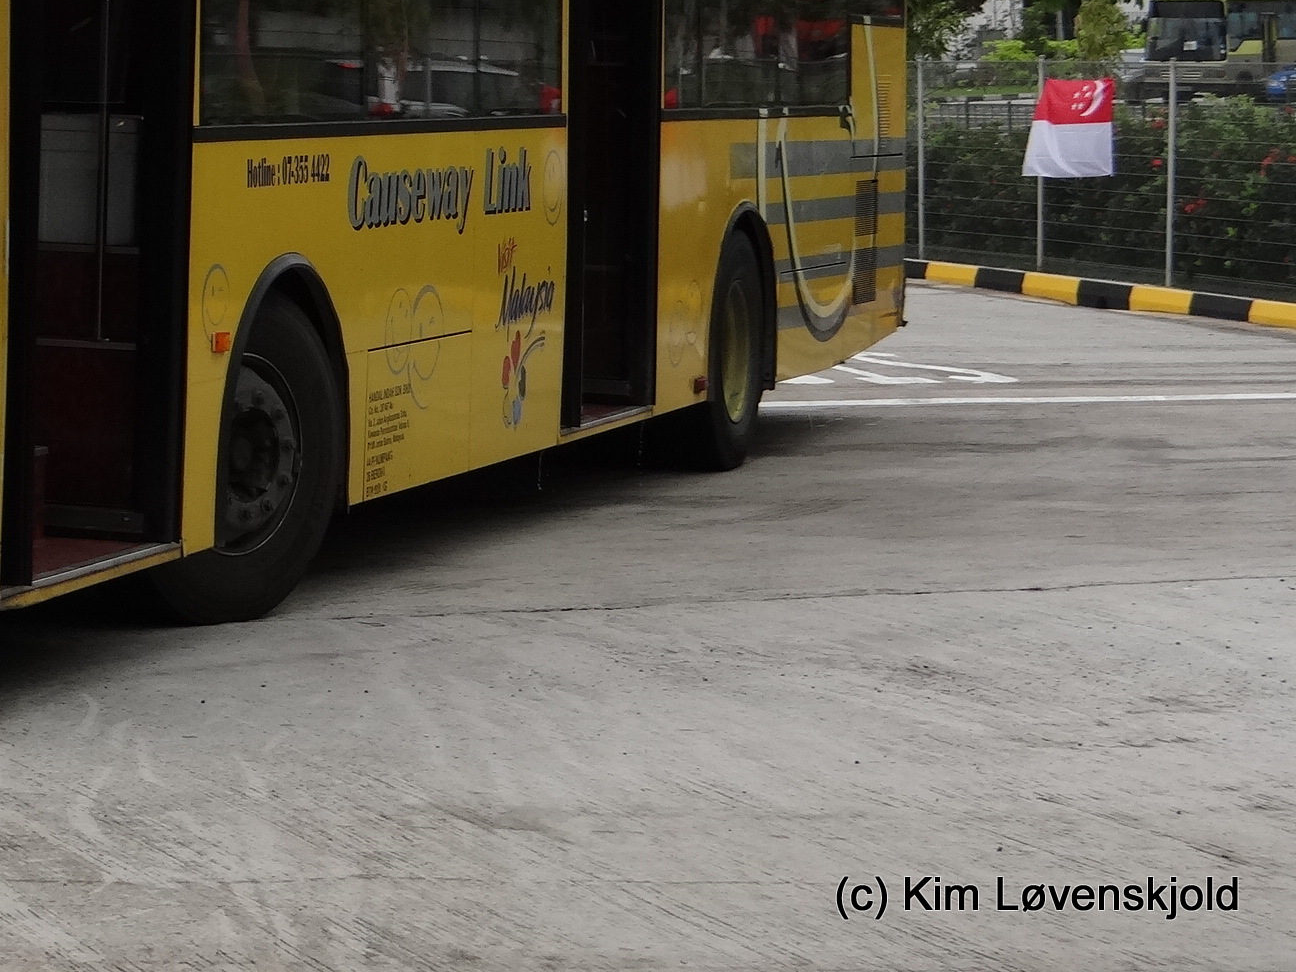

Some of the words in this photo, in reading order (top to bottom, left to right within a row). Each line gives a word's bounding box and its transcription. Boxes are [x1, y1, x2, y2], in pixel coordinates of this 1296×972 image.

[247, 157, 276, 188] Hotline
[282, 155, 309, 185] 07-355
[311, 154, 330, 182] 4422
[347, 155, 475, 235] Causeway
[483, 146, 532, 215] Link
[495, 265, 555, 341] Malaysia
